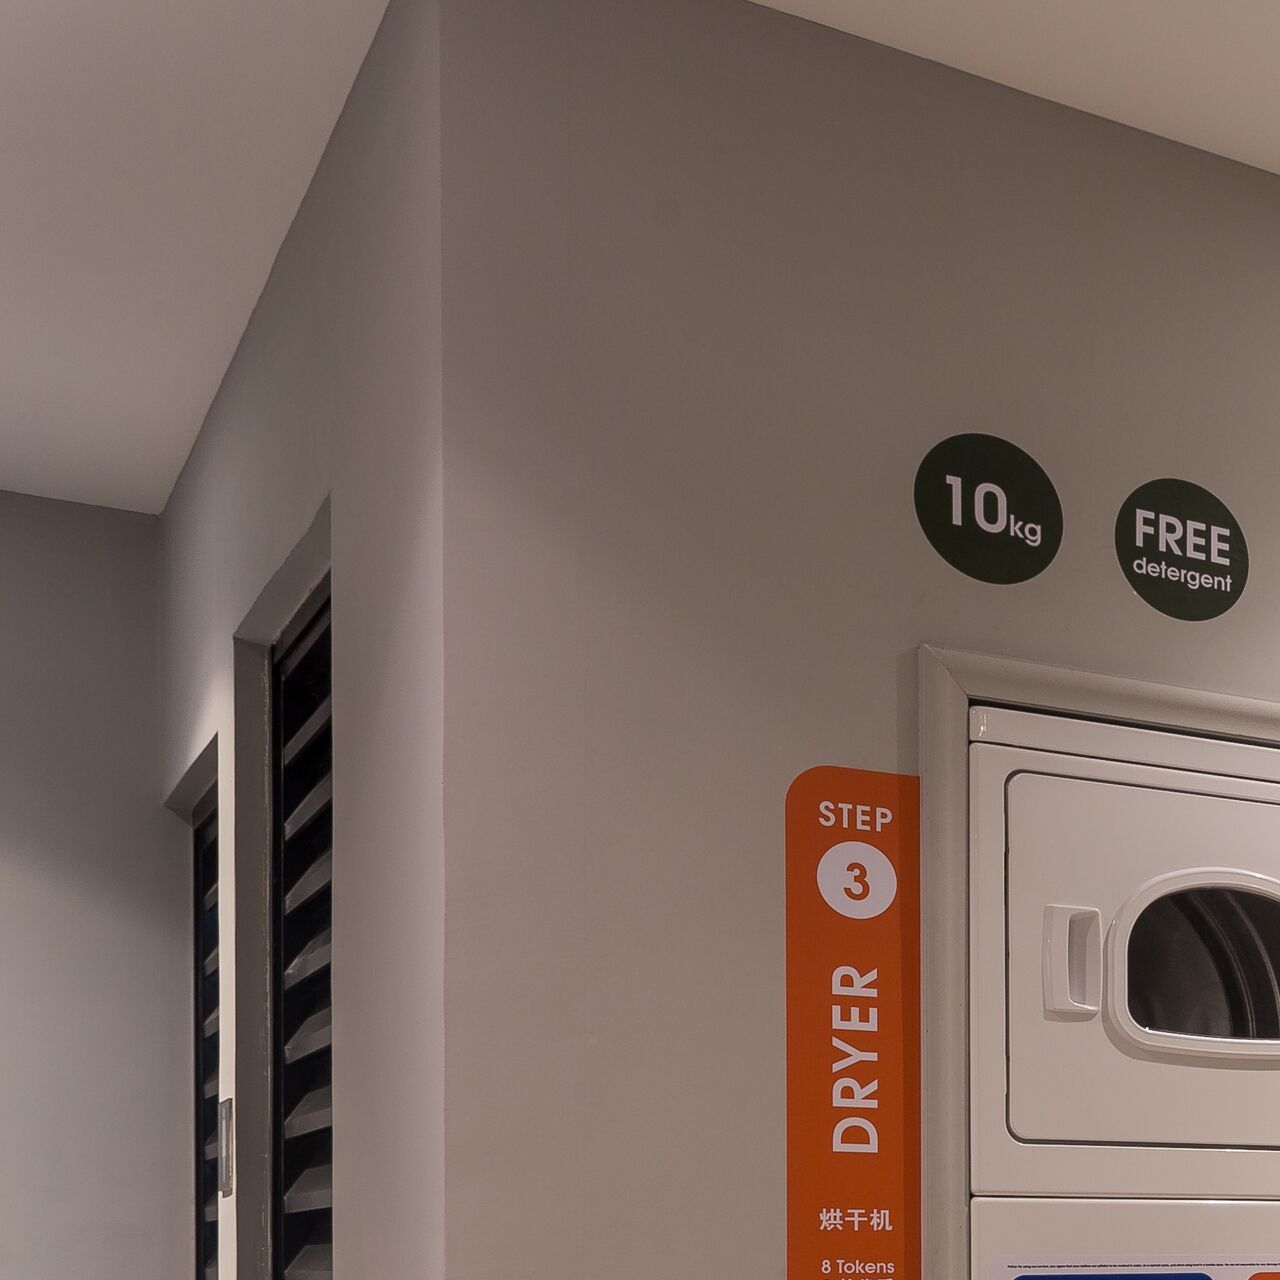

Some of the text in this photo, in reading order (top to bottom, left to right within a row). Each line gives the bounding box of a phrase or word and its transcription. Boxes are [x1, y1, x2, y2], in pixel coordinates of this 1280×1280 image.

[945, 474, 1042, 547] 10kg
[1135, 508, 1231, 566] FREE
[1133, 556, 1232, 593] detergent
[818, 801, 894, 833] STEP
[843, 862, 871, 901] 3
[831, 964, 879, 1155] DRYER
[819, 1208, 893, 1231] 烘干机
[822, 1258, 895, 1274] 8 Tokens
